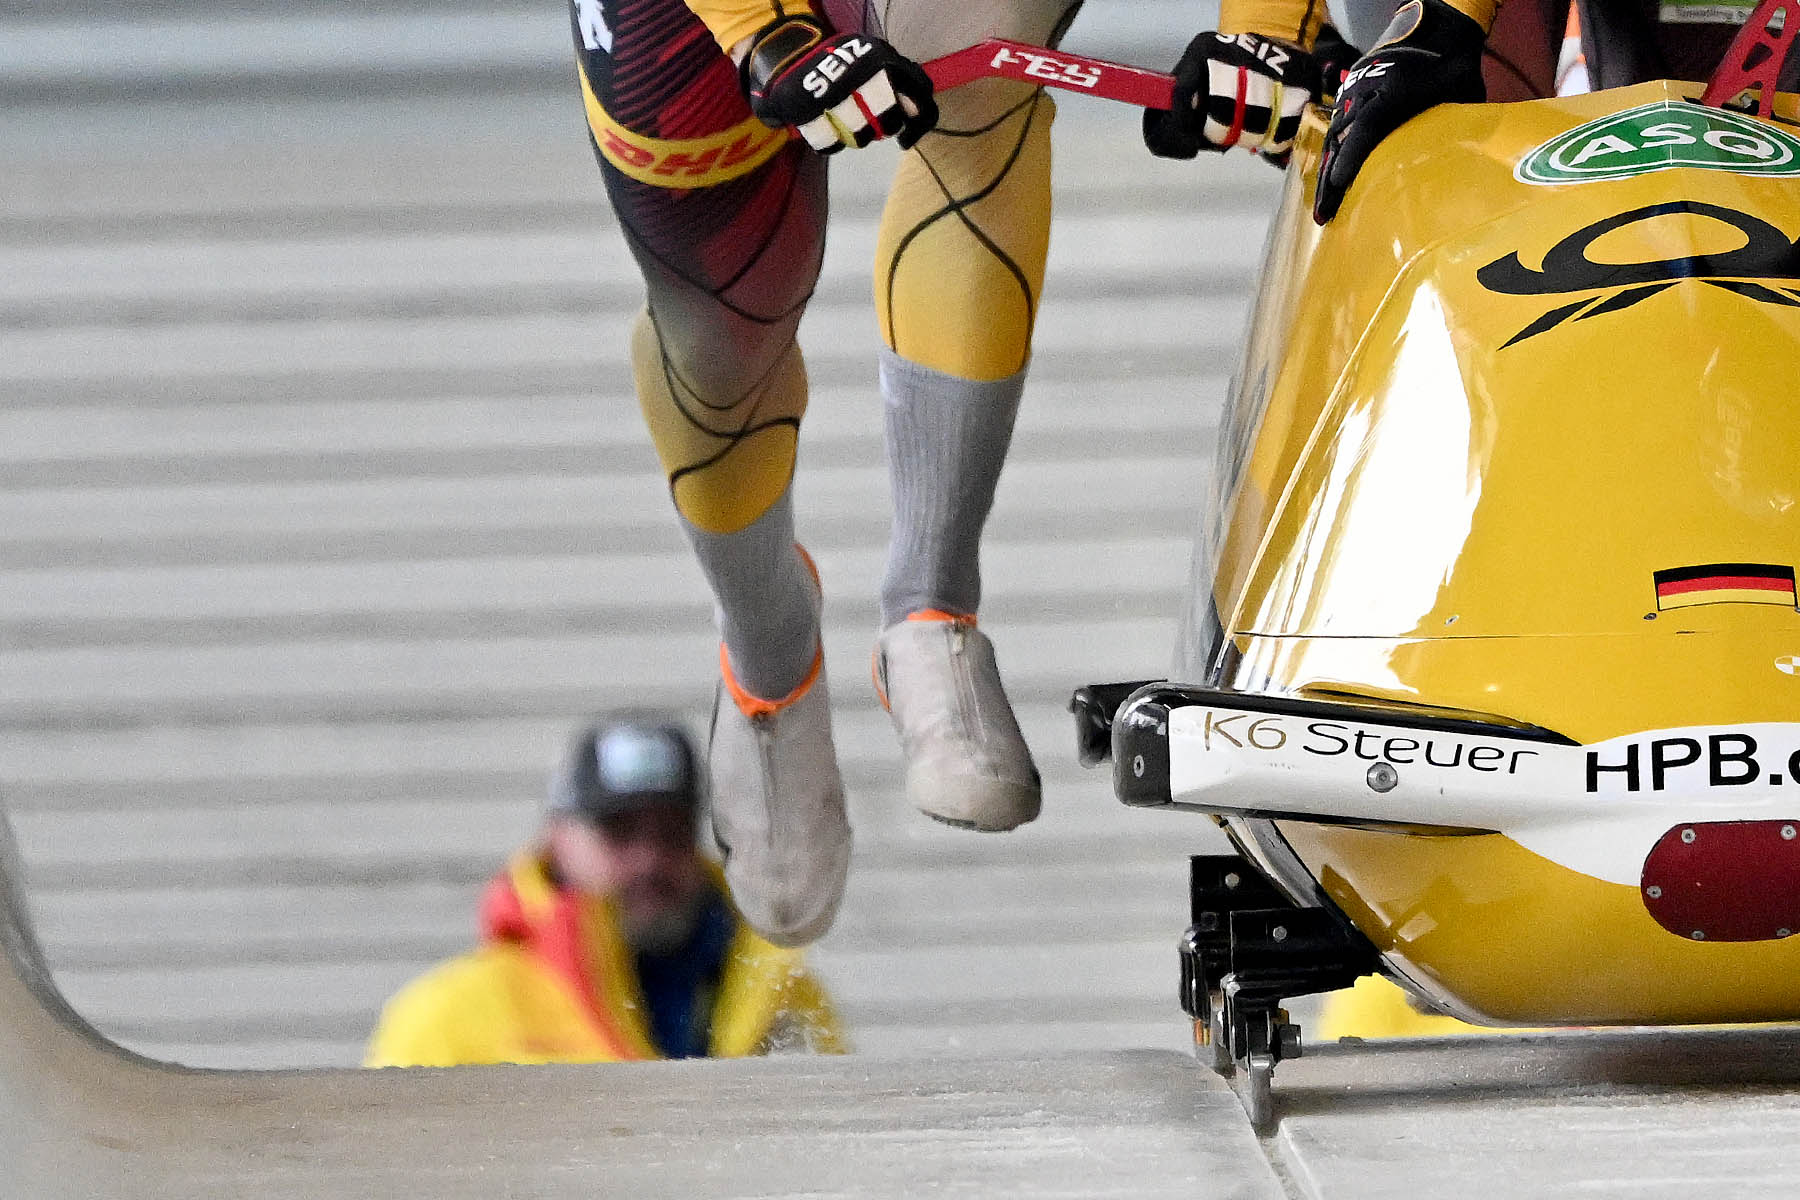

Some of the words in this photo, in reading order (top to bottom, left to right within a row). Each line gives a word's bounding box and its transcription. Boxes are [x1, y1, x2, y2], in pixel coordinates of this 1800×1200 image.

[604, 131, 765, 176] DHL
[1568, 123, 1776, 167] ASQ
[1203, 709, 1287, 752] K6
[1302, 722, 1540, 775] Steuer
